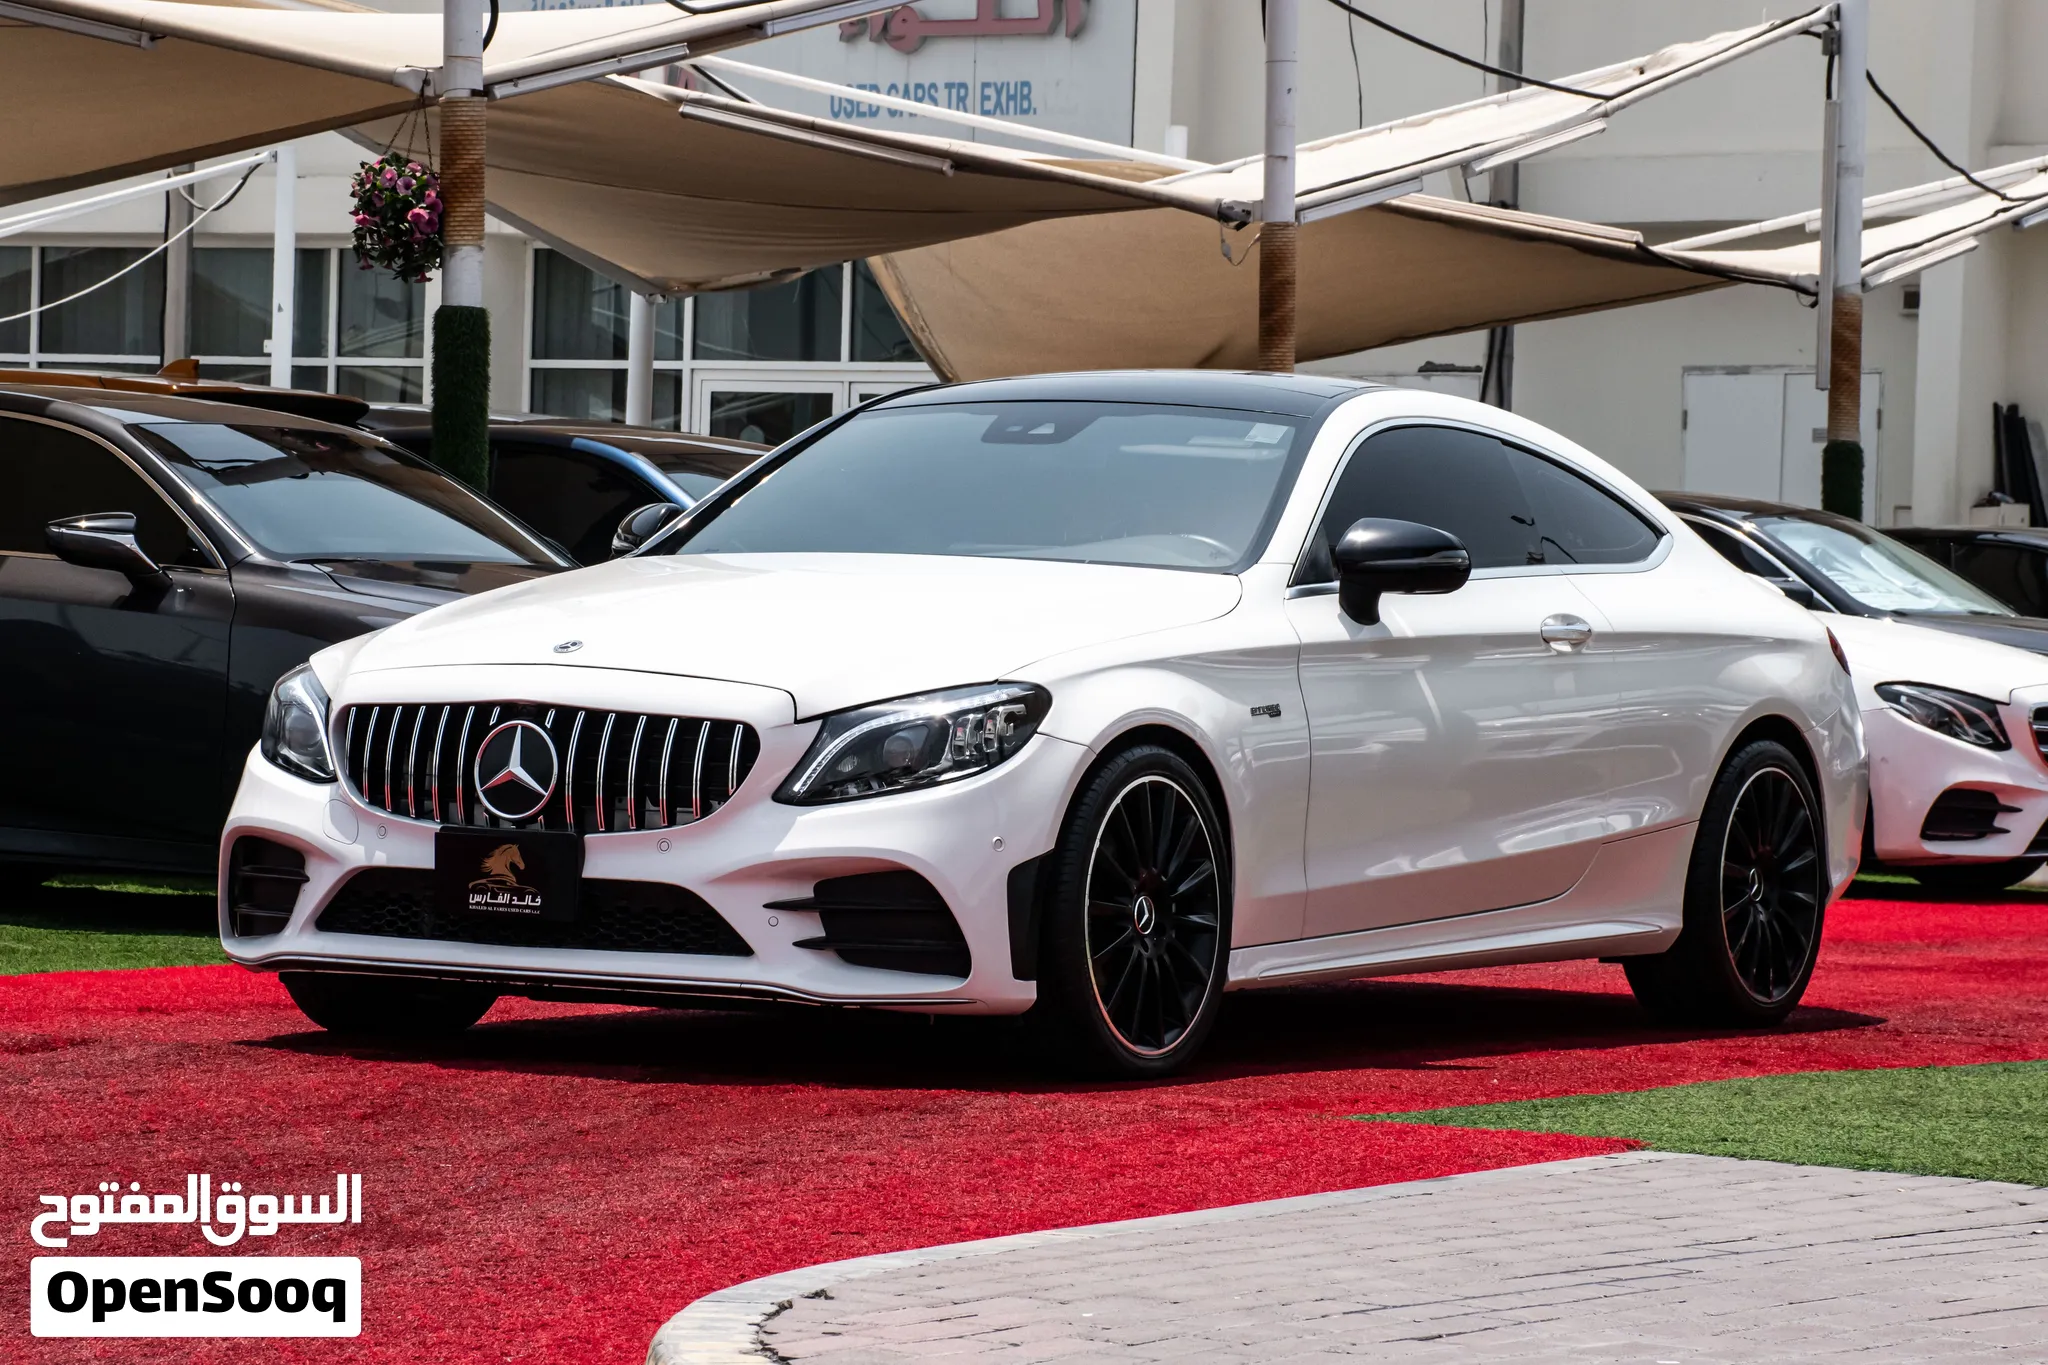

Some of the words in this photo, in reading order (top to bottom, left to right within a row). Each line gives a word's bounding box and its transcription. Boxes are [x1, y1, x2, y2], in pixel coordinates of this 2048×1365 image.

[830, 84, 881, 119] USED
[980, 81, 1037, 116] EXHB.
[469, 892, 511, 904] الفارس
[511, 894, 542, 906] خالد
